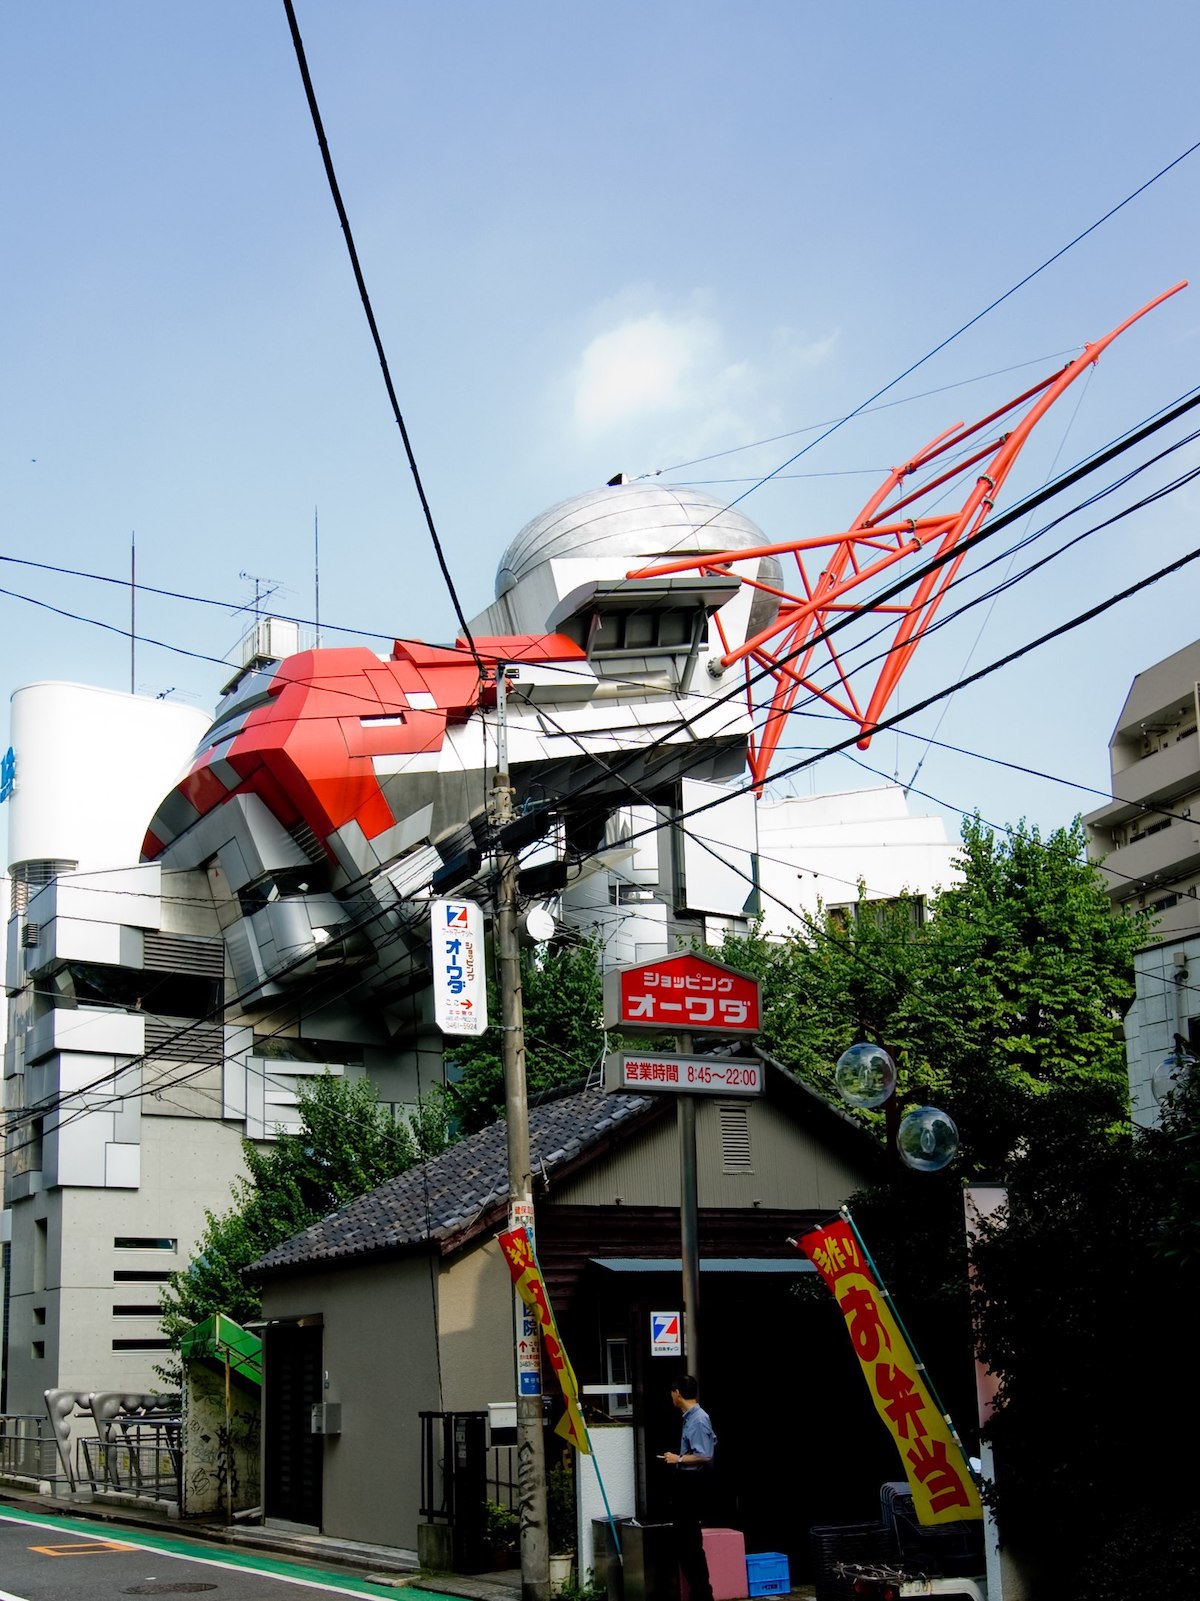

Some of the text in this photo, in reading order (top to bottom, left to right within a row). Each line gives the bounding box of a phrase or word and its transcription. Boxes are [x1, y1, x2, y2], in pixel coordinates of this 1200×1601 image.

[446, 938, 466, 994] オーワダ
[465, 941, 475, 981] ショッピング
[643, 971, 734, 992] ショッピング
[628, 993, 751, 1023] オーワダ
[625, 1061, 679, 1083] 営業時間
[812, 1236, 860, 1277] 手作り
[839, 1285, 971, 1515] お弁当
